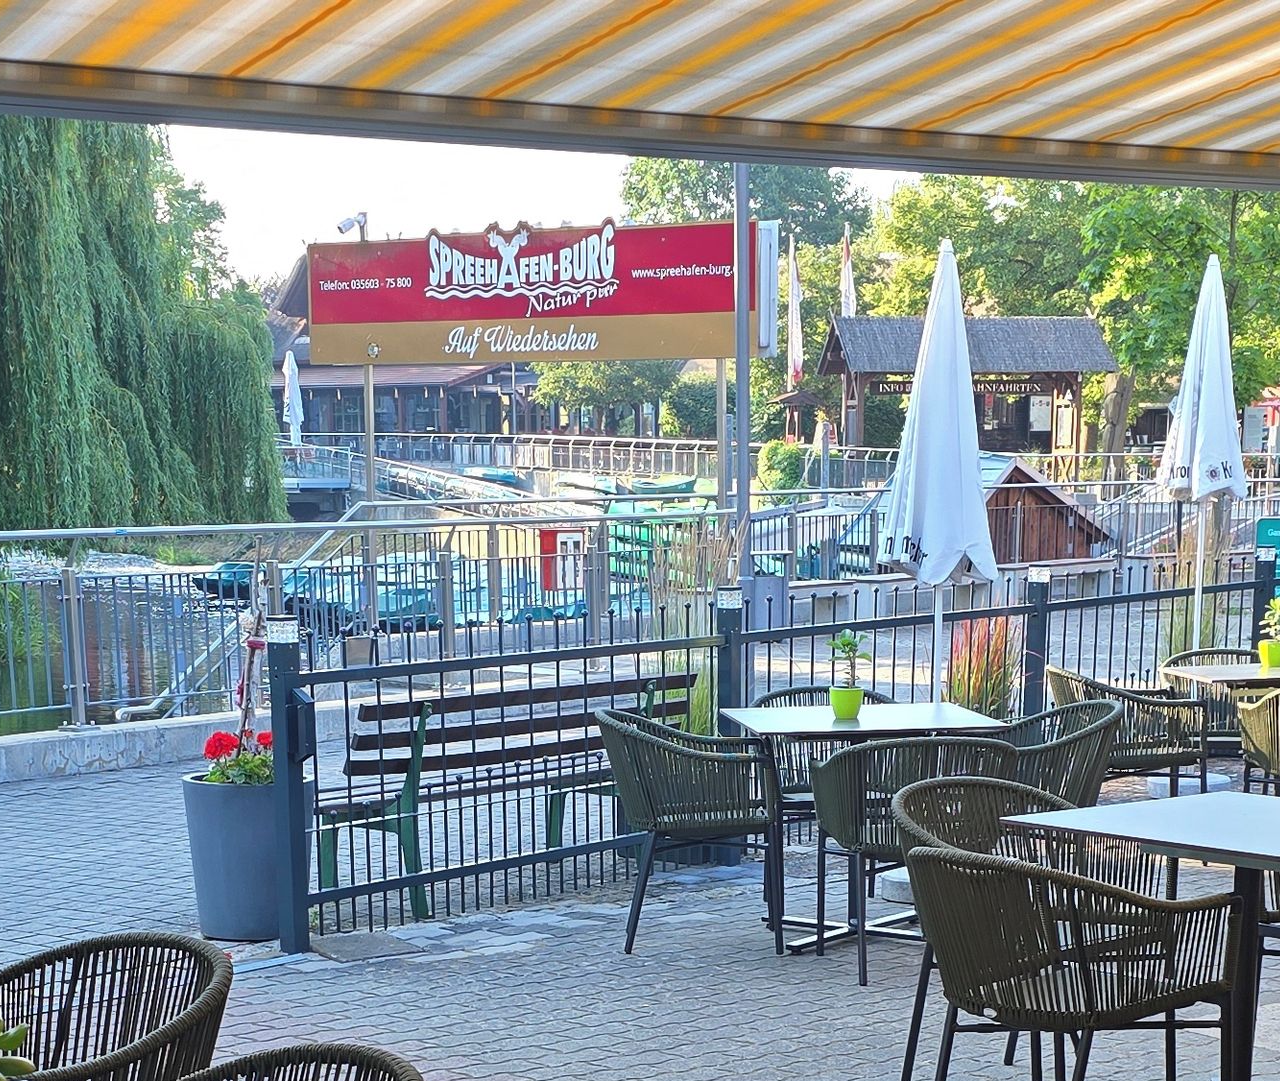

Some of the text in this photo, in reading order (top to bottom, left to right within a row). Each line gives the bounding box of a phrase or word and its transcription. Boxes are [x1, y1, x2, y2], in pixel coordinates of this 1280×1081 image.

[429, 224, 615, 289] SPREEHAFEN-BURG
[319, 279, 350, 291] Telefon:
[350, 278, 379, 290] 035603
[385, 277, 396, 288] 75
[396, 276, 412, 288] 800
[525, 282, 618, 318] Natur pur
[444, 323, 599, 359] Auf Wiedersehen
[879, 383, 904, 393] INFO
